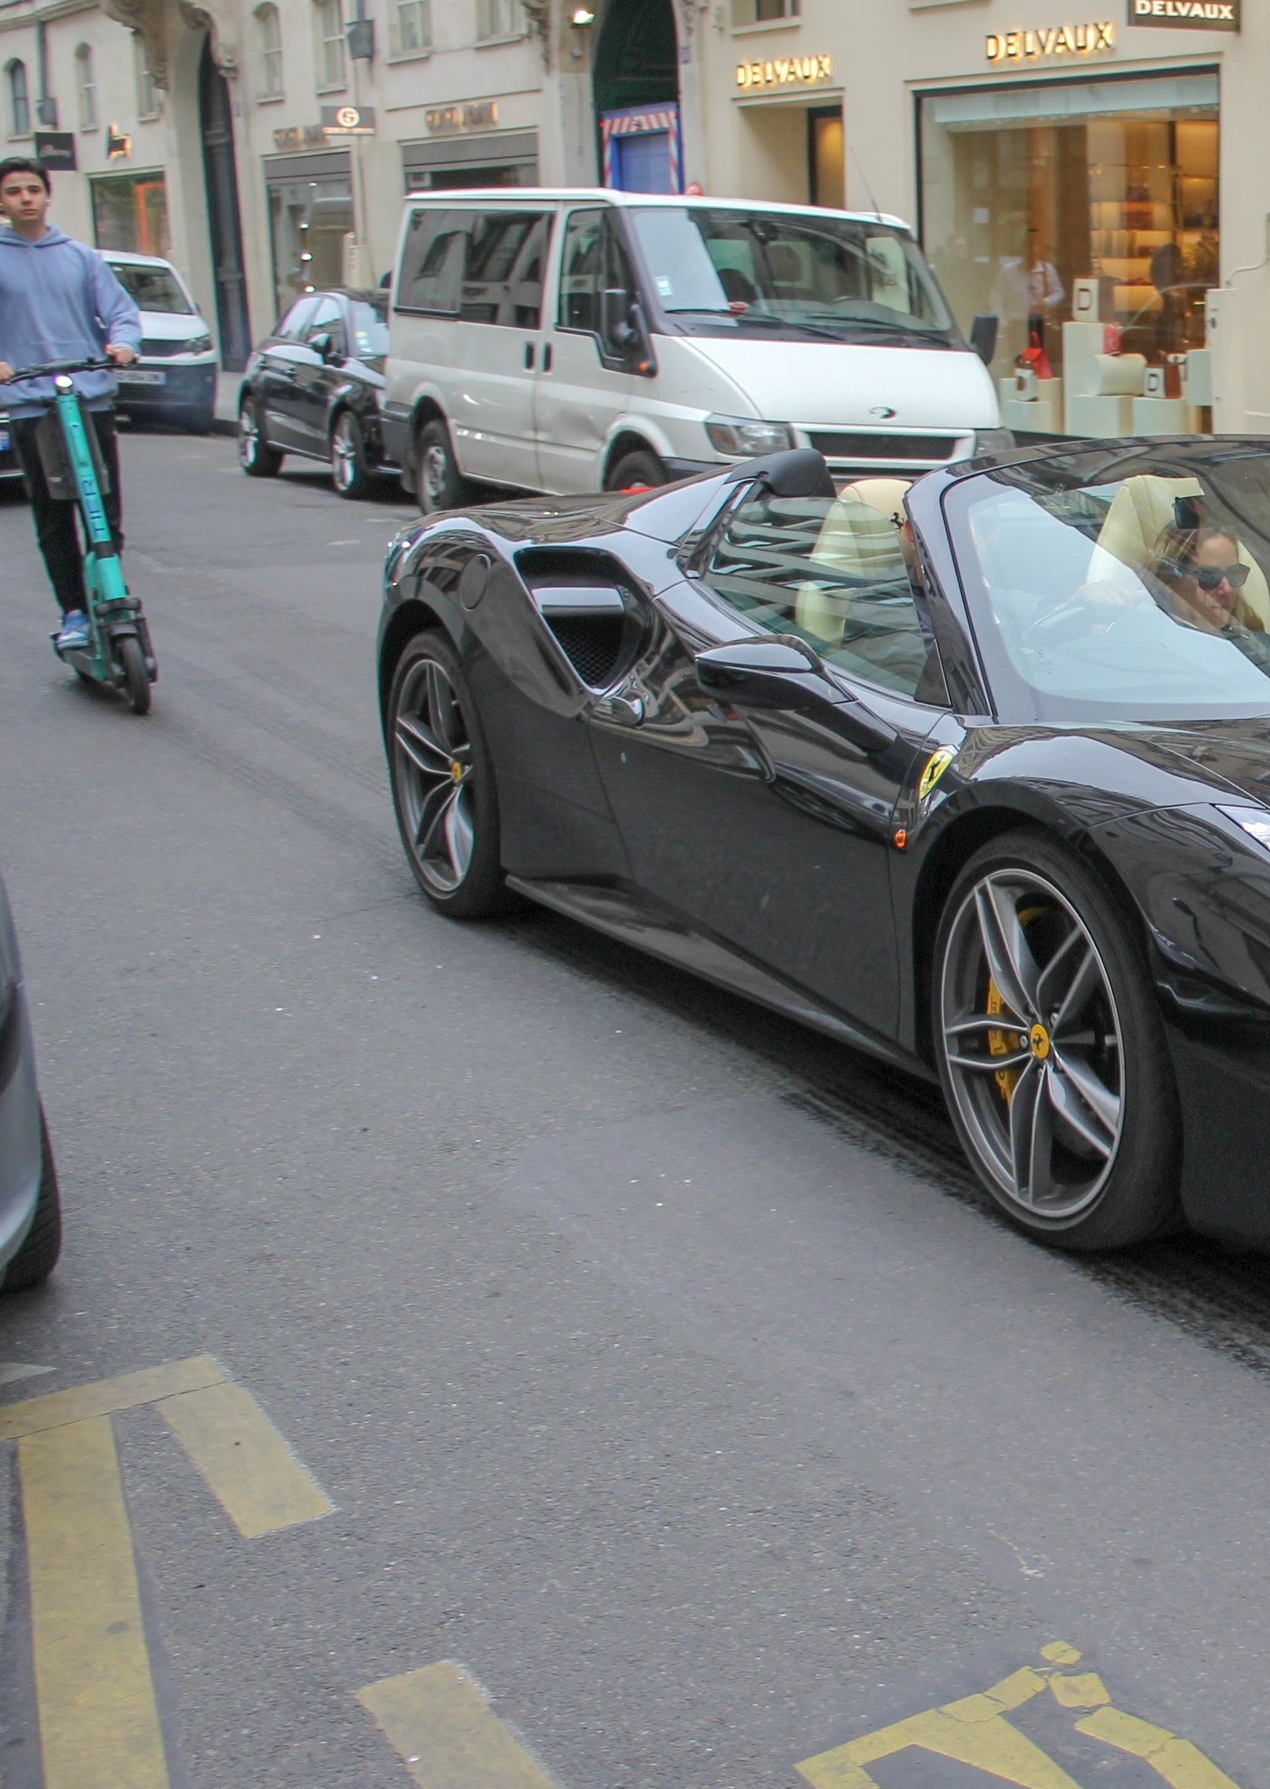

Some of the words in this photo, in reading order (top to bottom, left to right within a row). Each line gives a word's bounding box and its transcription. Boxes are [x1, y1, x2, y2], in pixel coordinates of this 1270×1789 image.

[1134, 0, 1235, 20] DELVAUX
[985, 22, 1115, 60] DELVAUX
[735, 55, 832, 87] DELVAUX
